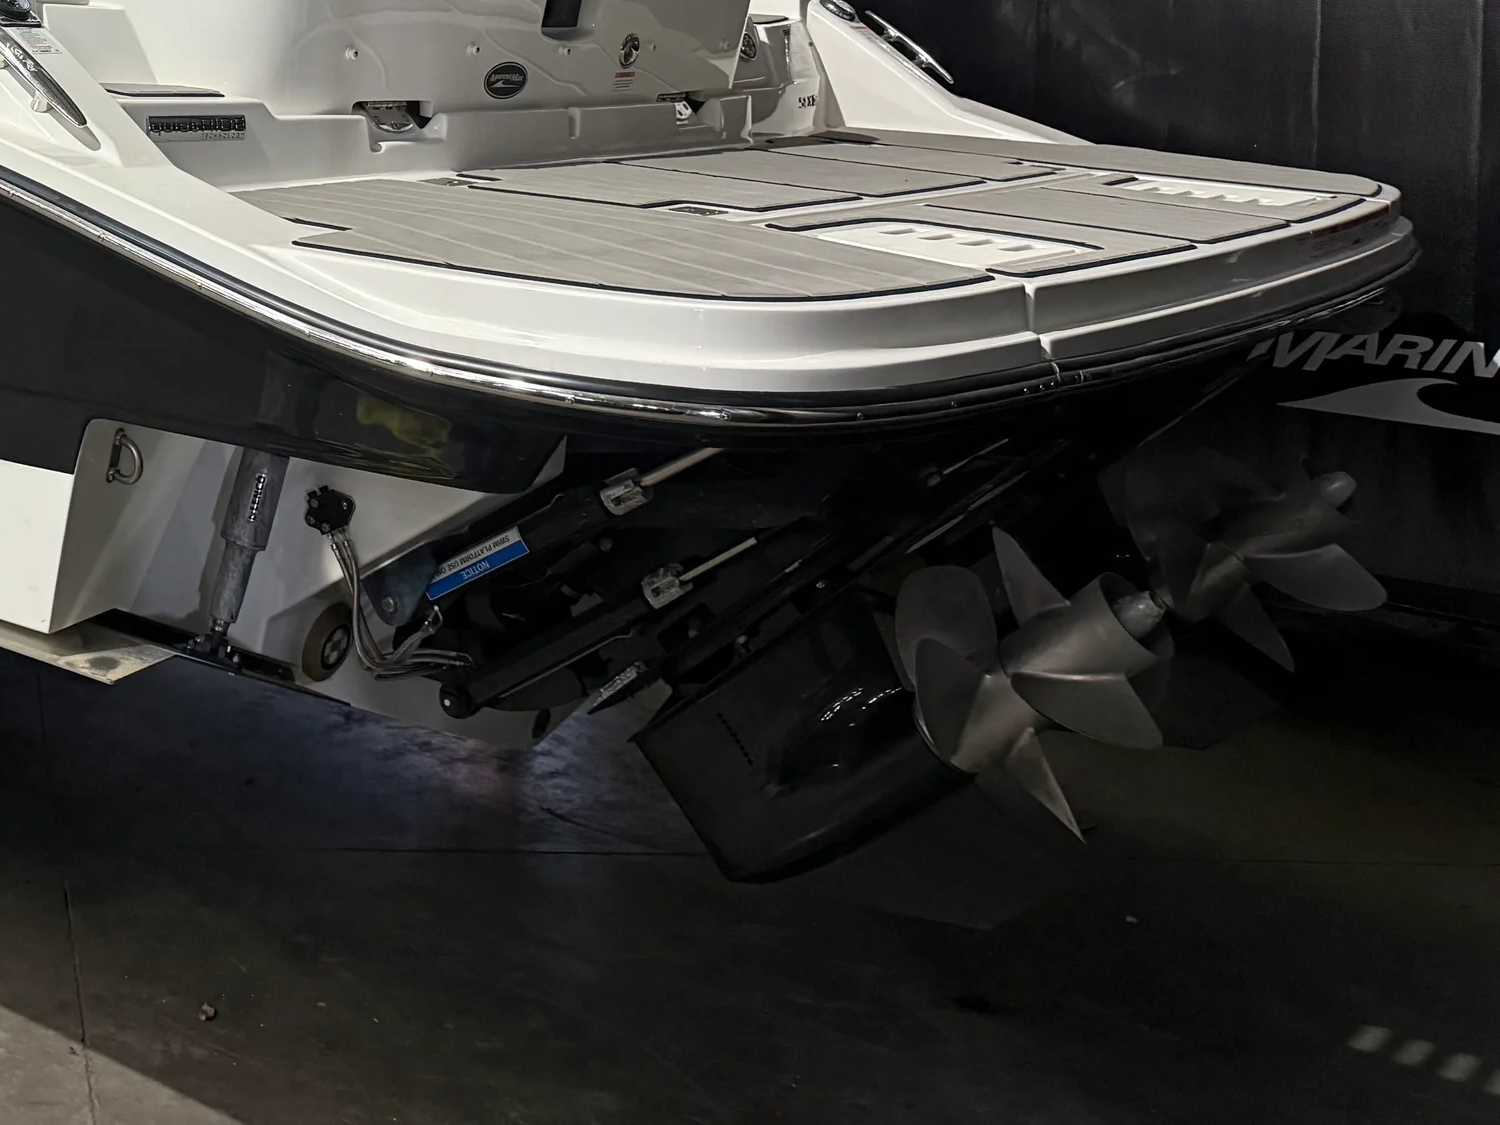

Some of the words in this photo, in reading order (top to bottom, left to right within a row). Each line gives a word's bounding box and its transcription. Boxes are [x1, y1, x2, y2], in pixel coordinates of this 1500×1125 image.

[492, 535, 510, 549] SWIM
[460, 545, 492, 565] PLATFORM
[447, 561, 461, 572] USE
[461, 560, 490, 579] NOTICE
